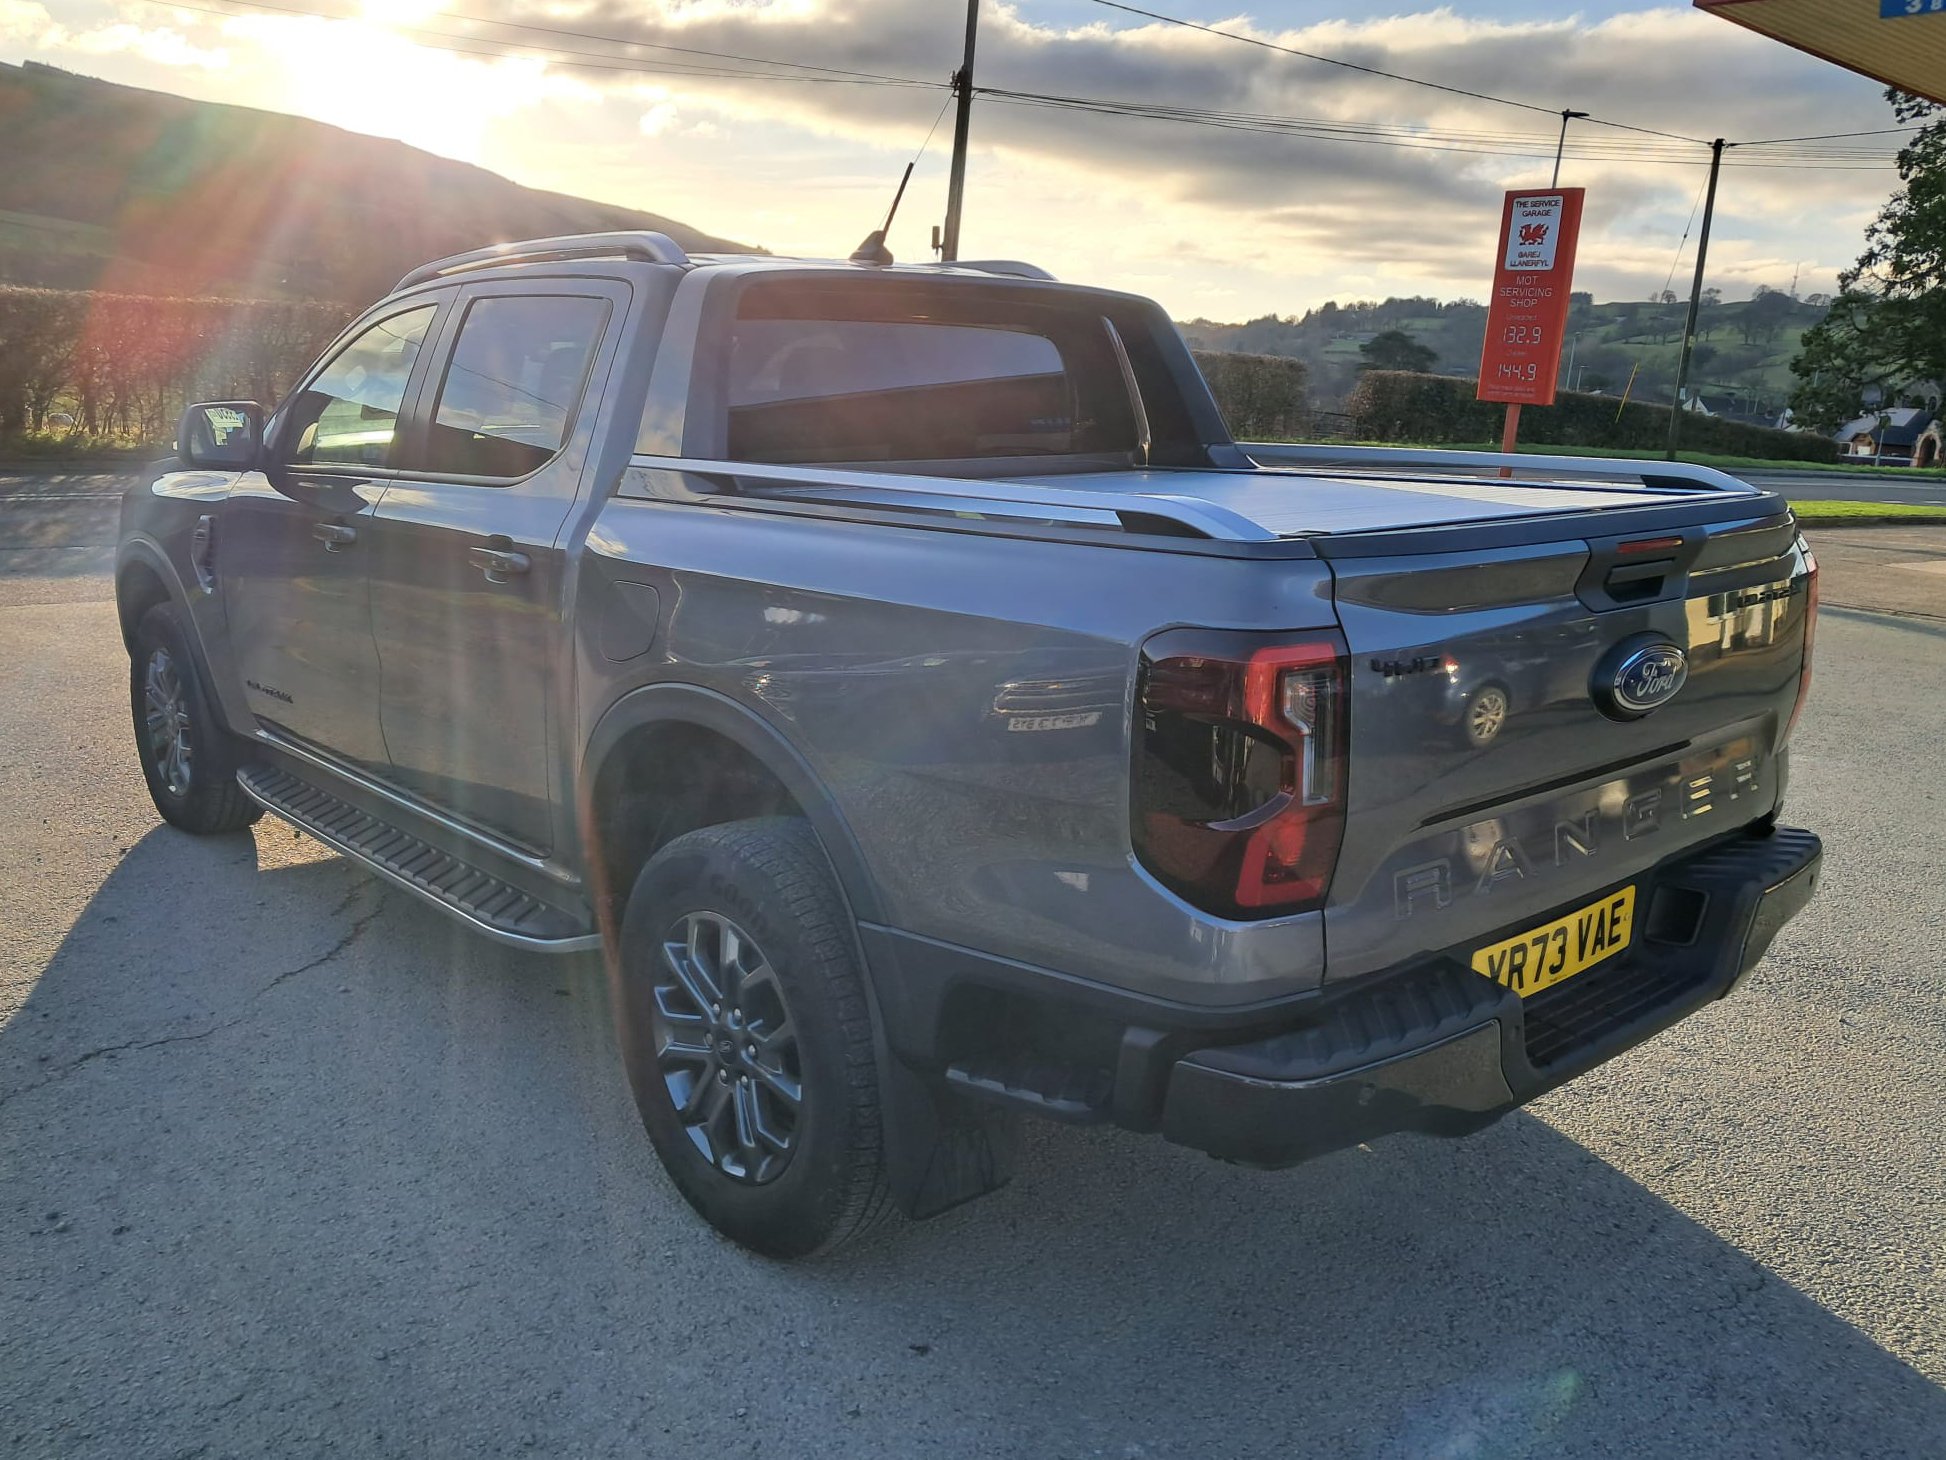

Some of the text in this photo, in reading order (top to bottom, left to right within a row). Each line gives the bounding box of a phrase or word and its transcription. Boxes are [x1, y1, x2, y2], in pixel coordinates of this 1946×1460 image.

[1530, 199, 1560, 207] SERVICE
[1516, 275, 1539, 285] MOT
[1500, 287, 1552, 297] SERVICING
[1509, 299, 1538, 308] SHOP
[1503, 326, 1542, 344] 132.9
[1498, 363, 1537, 381] 144.9
[1636, 661, 1678, 697] Ford
[1394, 760, 1759, 921] RANGER
[1577, 897, 1625, 963] VAE
